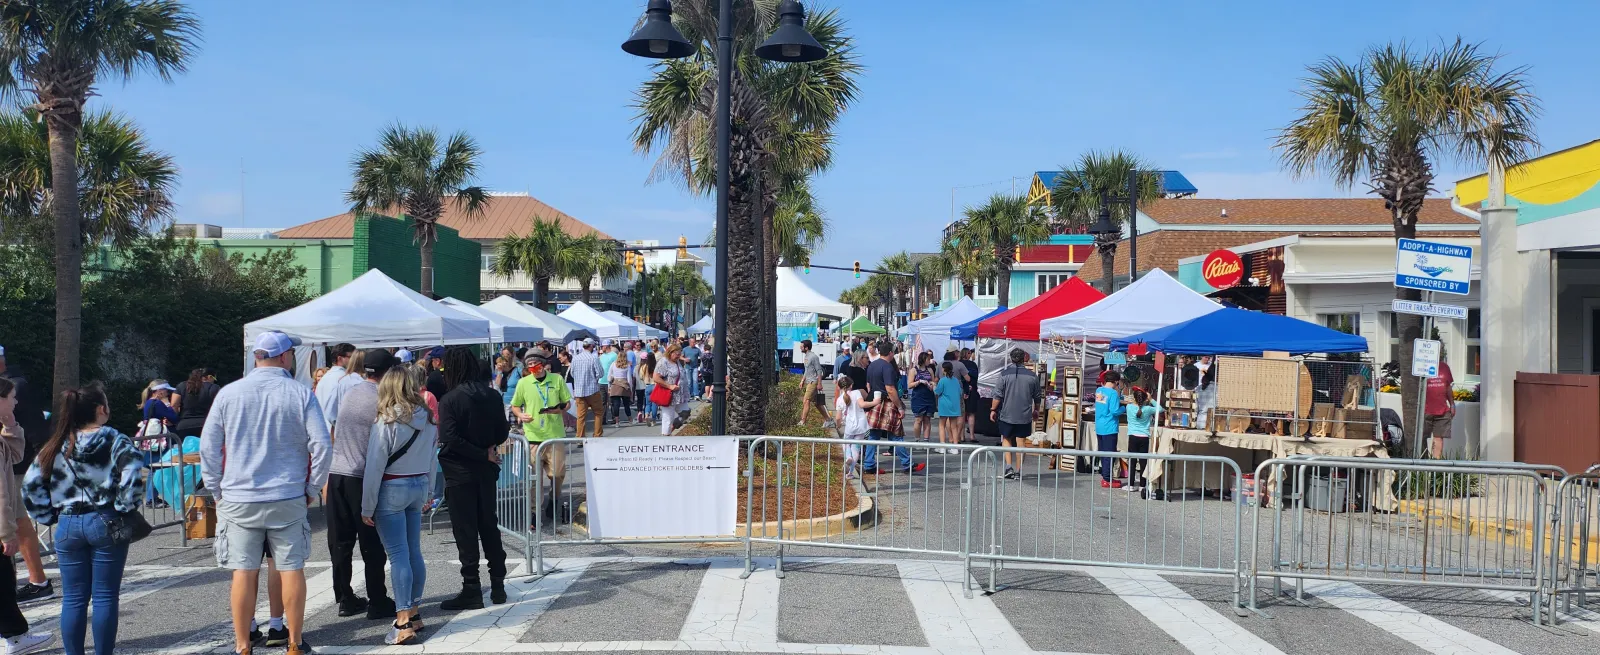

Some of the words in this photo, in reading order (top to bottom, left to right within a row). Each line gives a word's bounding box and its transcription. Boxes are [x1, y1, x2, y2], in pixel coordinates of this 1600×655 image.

[1402, 241, 1469, 257] ADOPT-A-HIGHWAY
[1205, 257, 1240, 280] Rita's
[1404, 276, 1447, 289] SPONSORED
[1449, 282, 1460, 291] BY
[1395, 302, 1412, 310] LITTER
[1413, 304, 1437, 314] TRASHES
[1437, 306, 1465, 317] EVERYONE
[618, 445, 650, 454] EVENT
[652, 444, 705, 453] ENTRANCE
